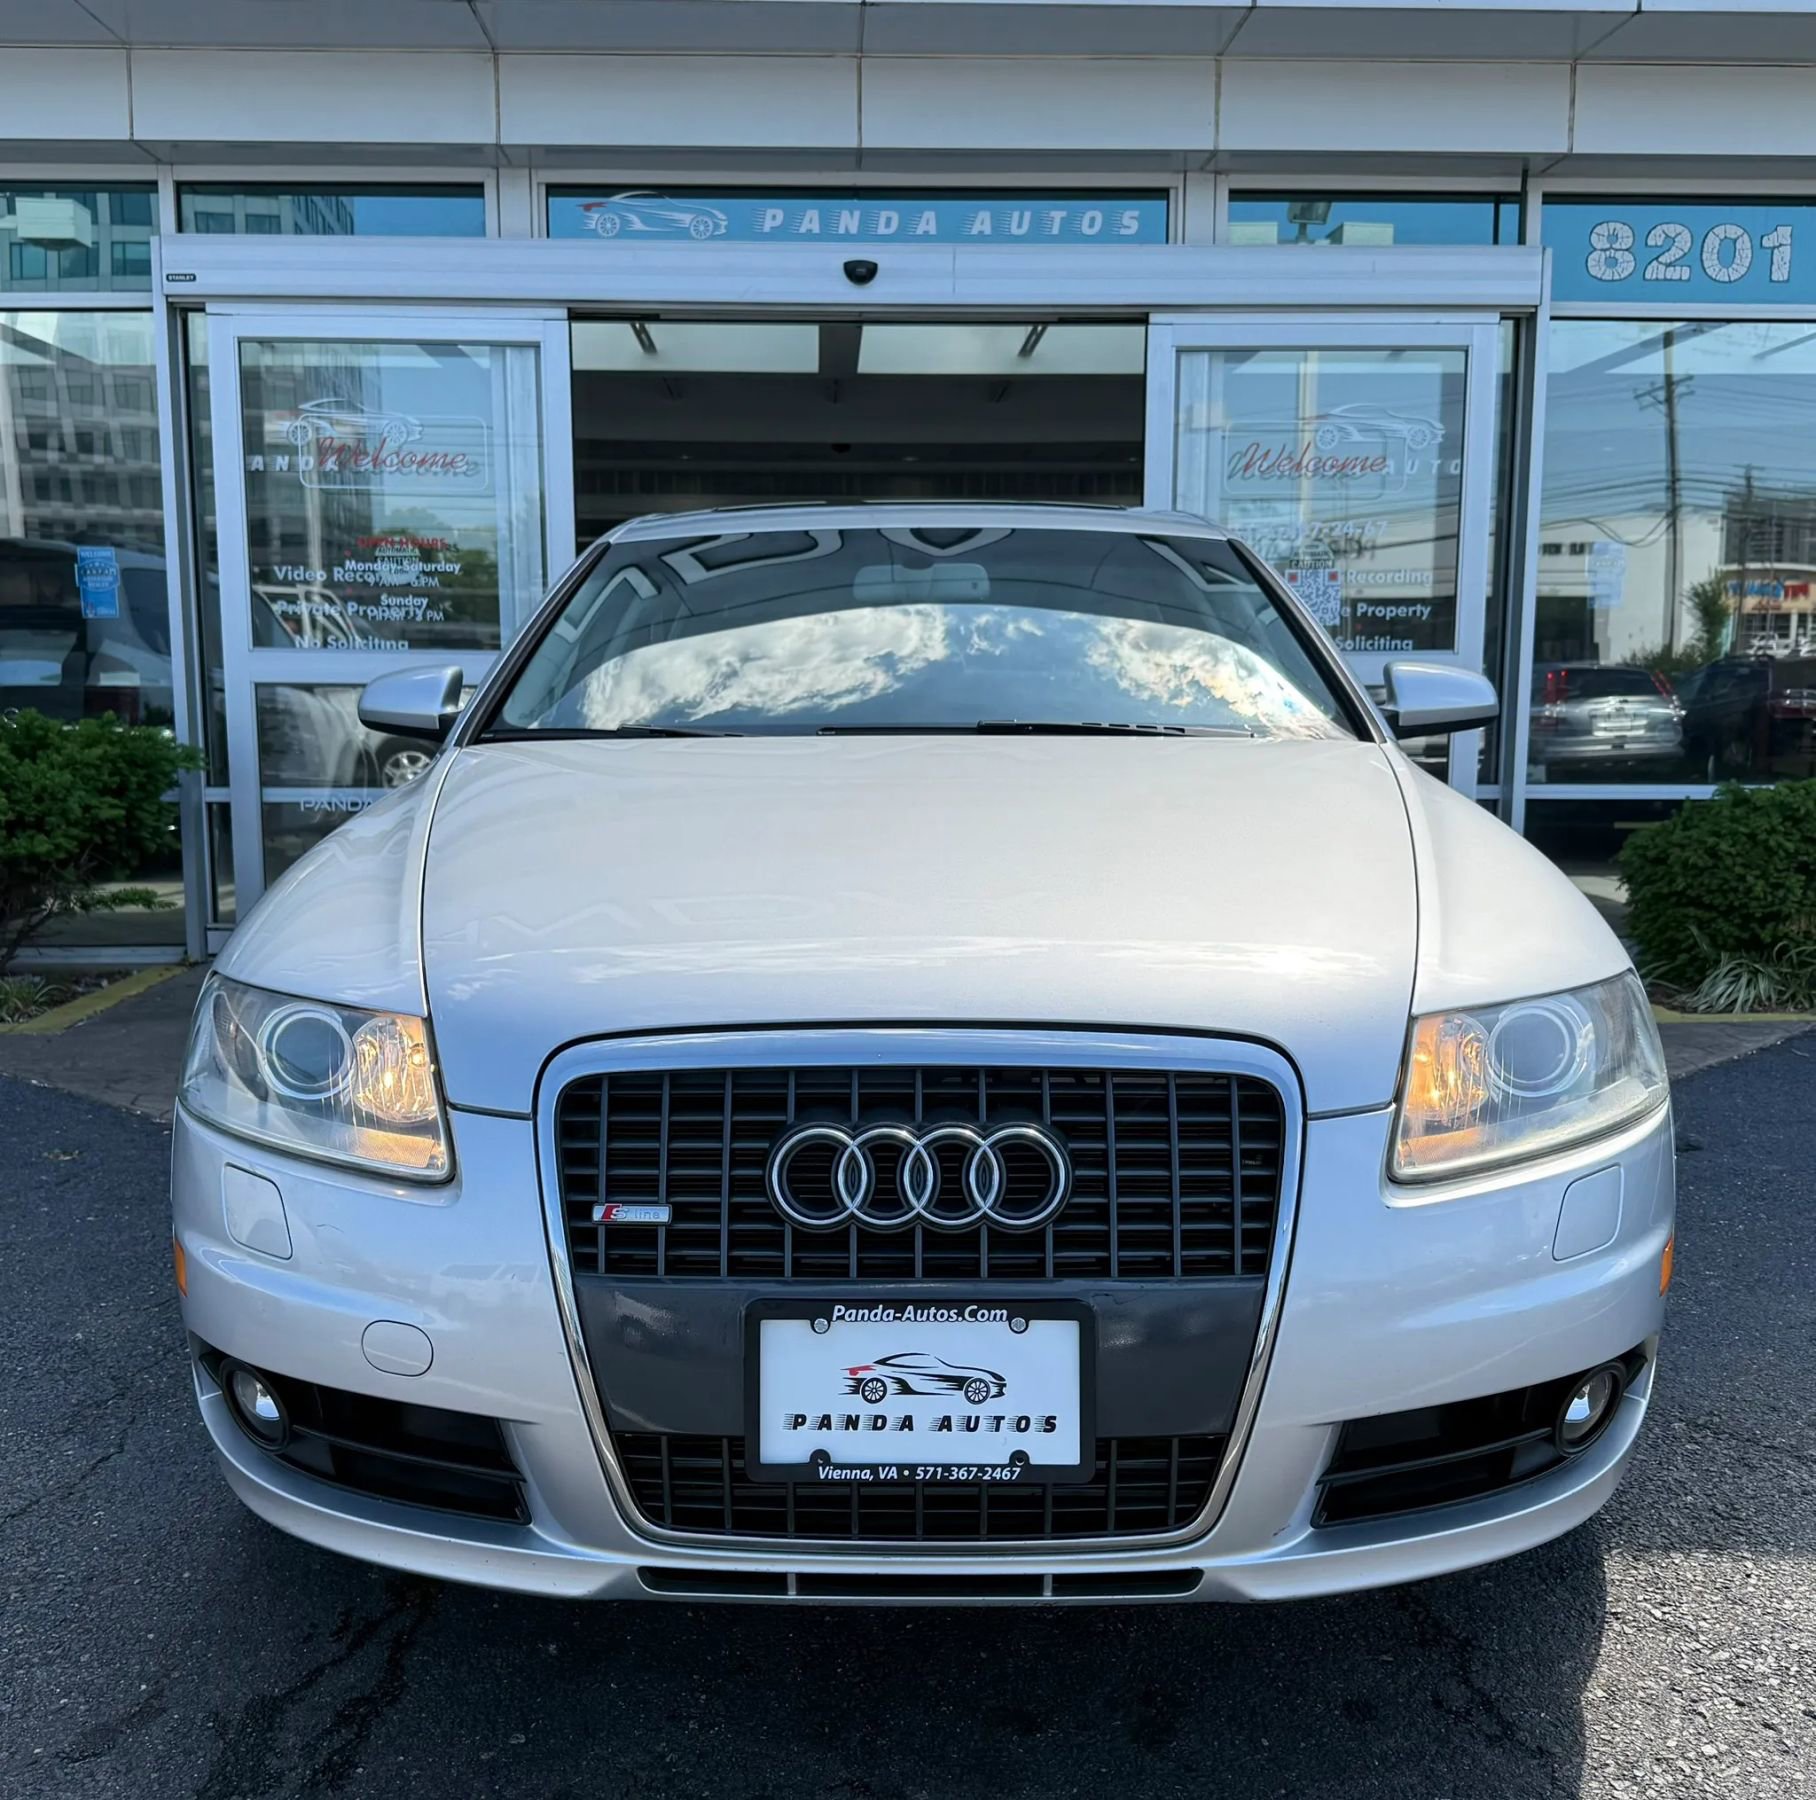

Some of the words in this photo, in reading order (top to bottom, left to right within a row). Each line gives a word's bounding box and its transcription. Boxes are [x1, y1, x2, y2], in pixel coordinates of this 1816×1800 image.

[754, 207, 937, 235] PANDA
[962, 209, 1140, 236] AUTOS
[1586, 221, 1793, 283] 8201
[317, 436, 469, 470] Welcome
[1243, 441, 1388, 474] Welcome
[273, 566, 327, 582] Video
[1347, 569, 1433, 588] Recording
[381, 594, 429, 613] Sunday
[1356, 603, 1431, 620] Property
[295, 637, 320, 650] No
[327, 637, 409, 650] Soliciting
[1334, 636, 1413, 651] Soliciting
[832, 1304, 1008, 1323] Panda-Autos.Com
[783, 1413, 914, 1432] PANDA
[929, 1415, 1057, 1433] AUTOS
[817, 1466, 874, 1481] Vienna,
[877, 1466, 898, 1480] VA
[914, 1467, 1021, 1481] 571-367-2467
